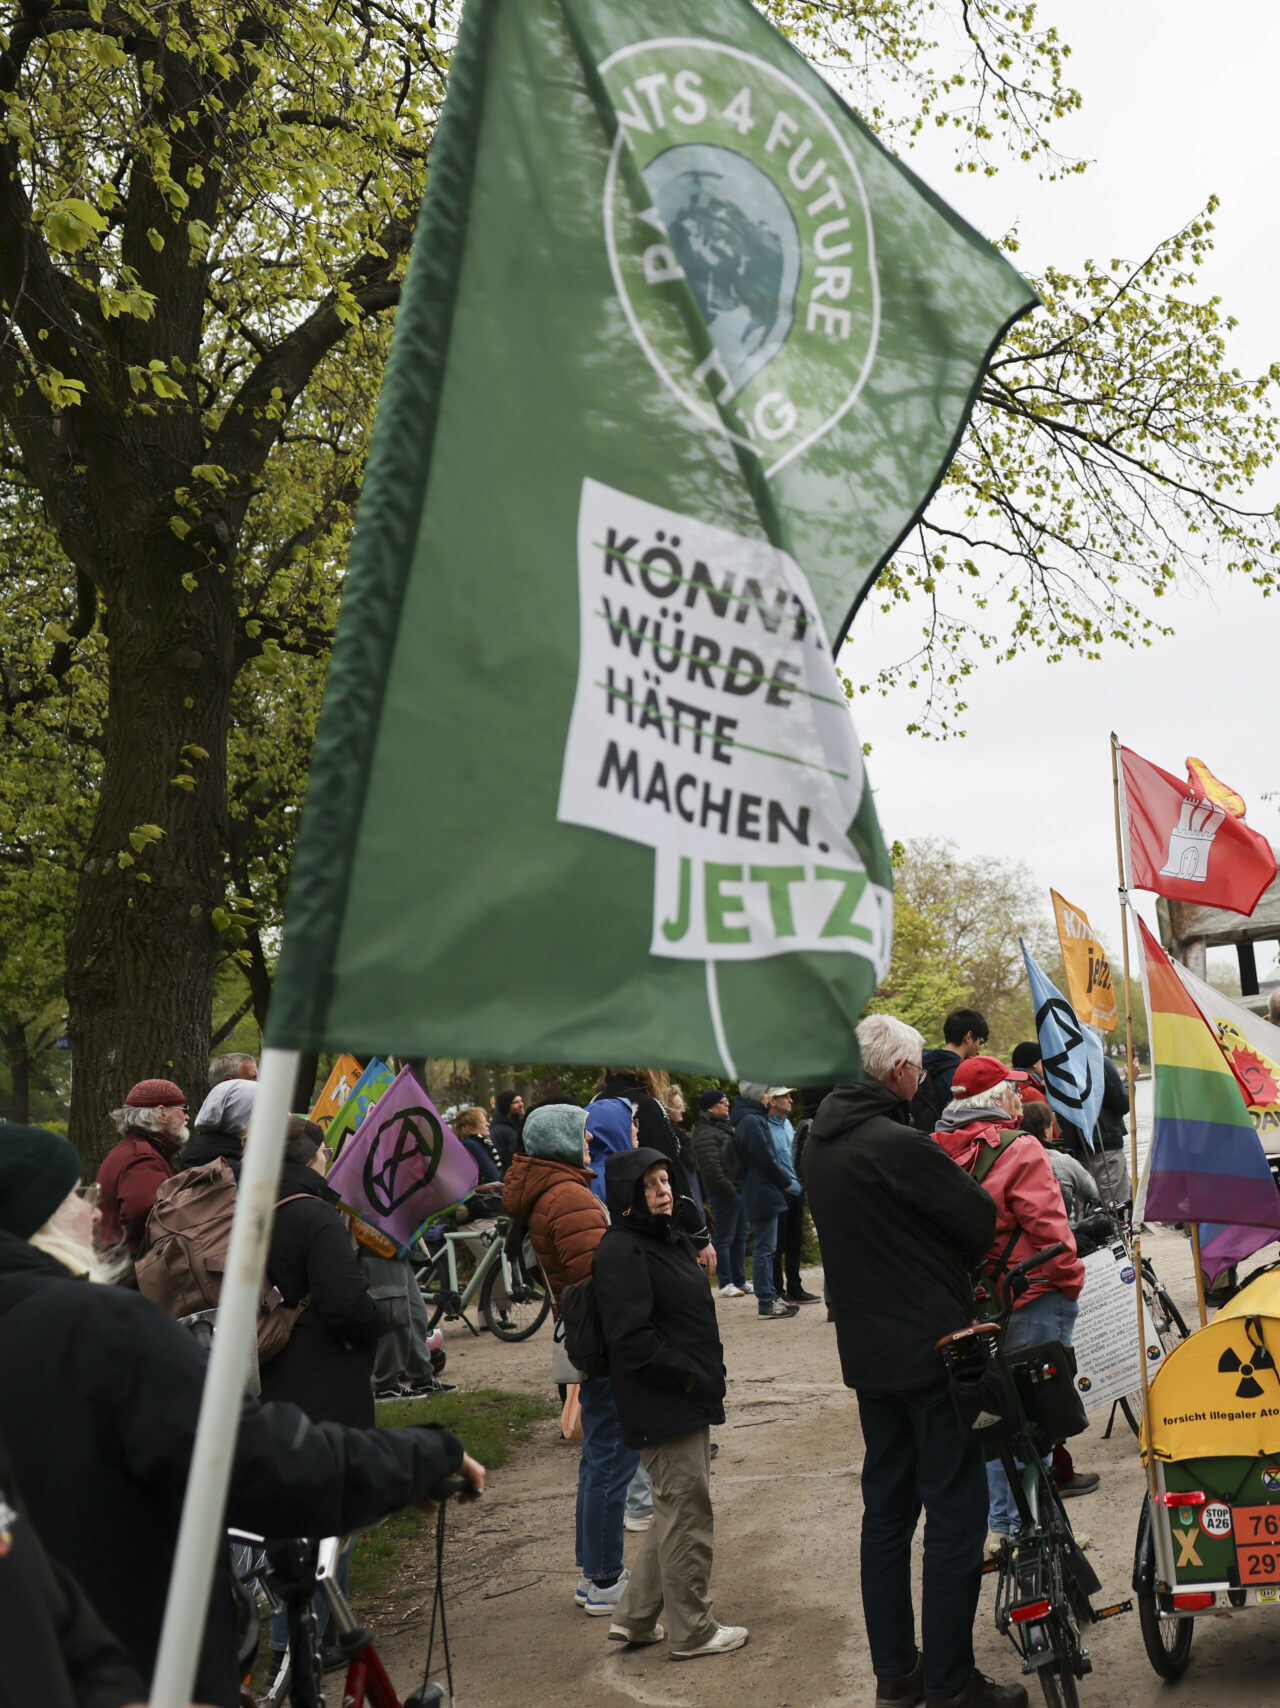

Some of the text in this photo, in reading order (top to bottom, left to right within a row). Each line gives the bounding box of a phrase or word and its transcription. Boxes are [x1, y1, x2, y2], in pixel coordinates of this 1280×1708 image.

[722, 86, 755, 136] 4
[764, 110, 853, 340] FUTURE
[602, 594, 802, 708] WÜRDE
[607, 665, 738, 765] HÄTTE
[597, 739, 830, 854] MACHEN.
[661, 855, 886, 958] JETZ
[1163, 1412, 1206, 1426] forsicht
[1210, 1410, 1257, 1421] illegaler
[1206, 1508, 1228, 1518] STOP
[1207, 1518, 1229, 1529] A26
